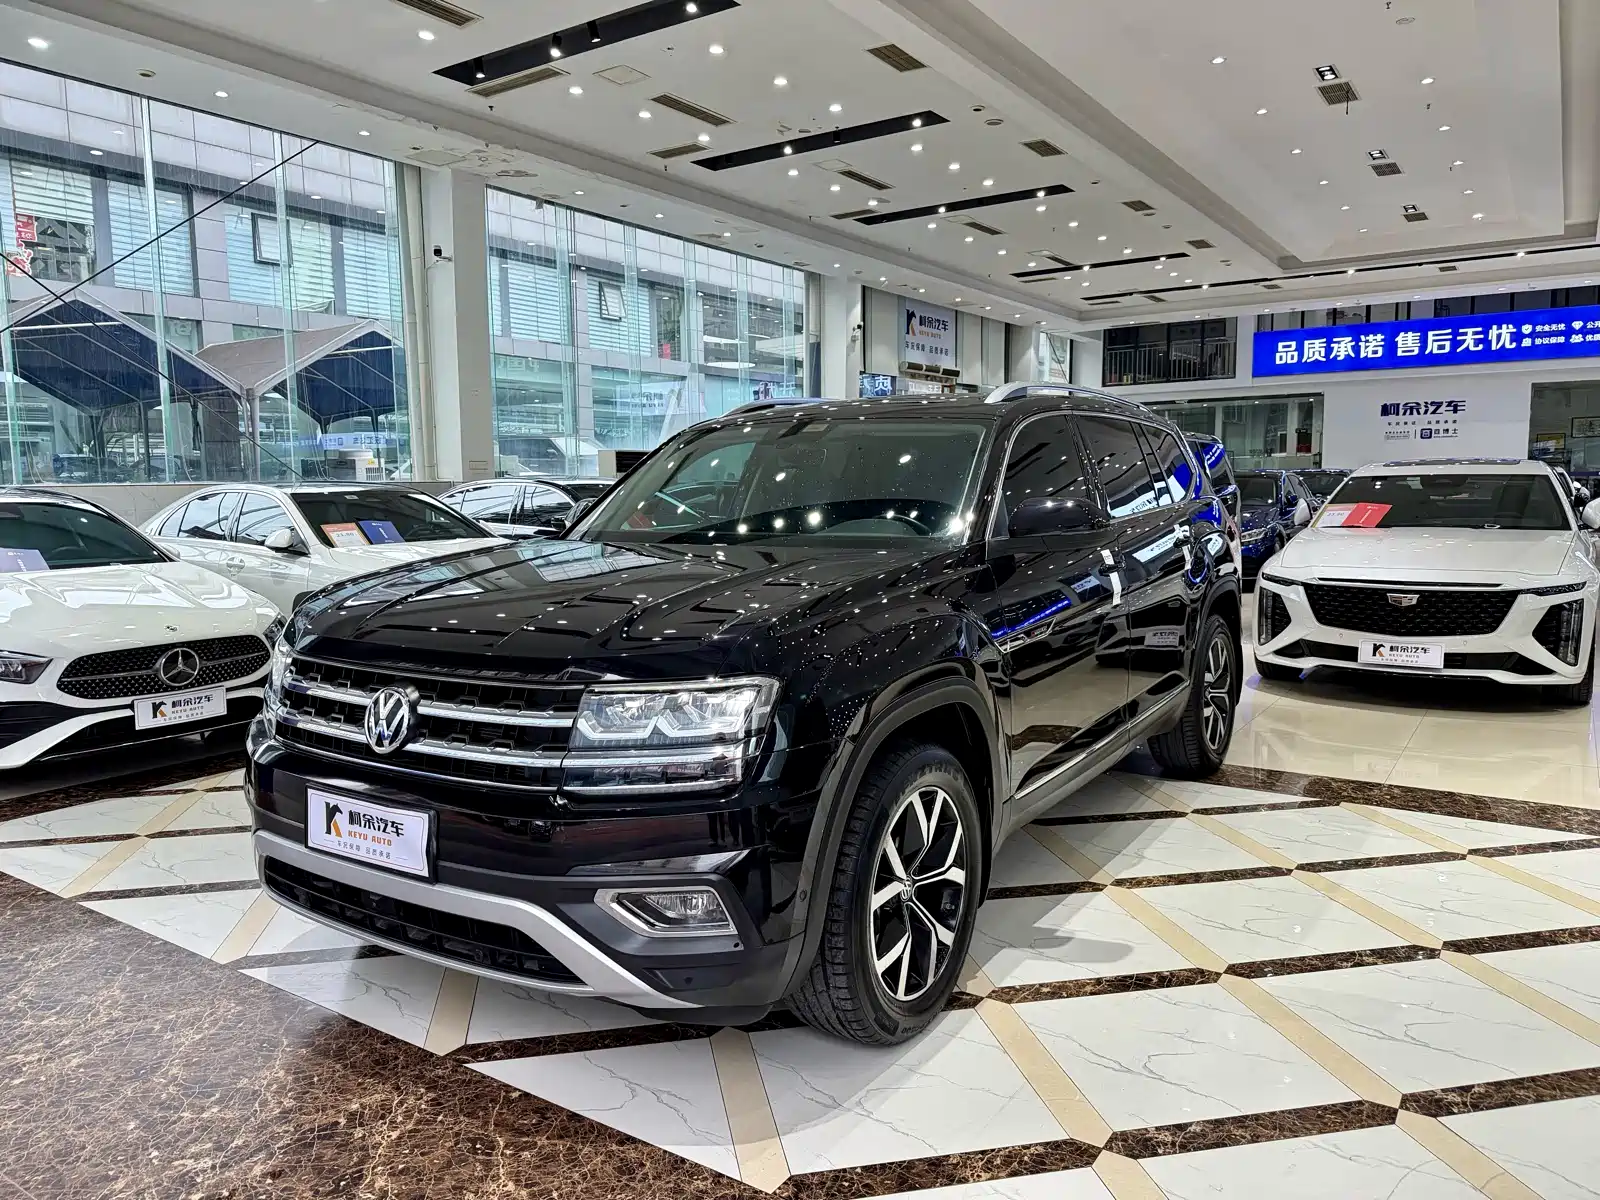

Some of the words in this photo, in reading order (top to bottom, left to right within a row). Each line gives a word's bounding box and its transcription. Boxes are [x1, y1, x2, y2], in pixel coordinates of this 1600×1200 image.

[918, 314, 949, 332] 柯余汽车
[1535, 323, 1566, 332] 安全无忧
[1275, 334, 1385, 365] 品质承诺
[1395, 324, 1517, 357] 售后无忧
[1380, 400, 1467, 417] 柯余汽车
[1389, 645, 1431, 654] 柯余汽车
[171, 694, 214, 709] 柯余汽车
[348, 809, 405, 838] 柯余汽车
[347, 830, 368, 841] KEYU
[371, 835, 392, 847] AUTO
